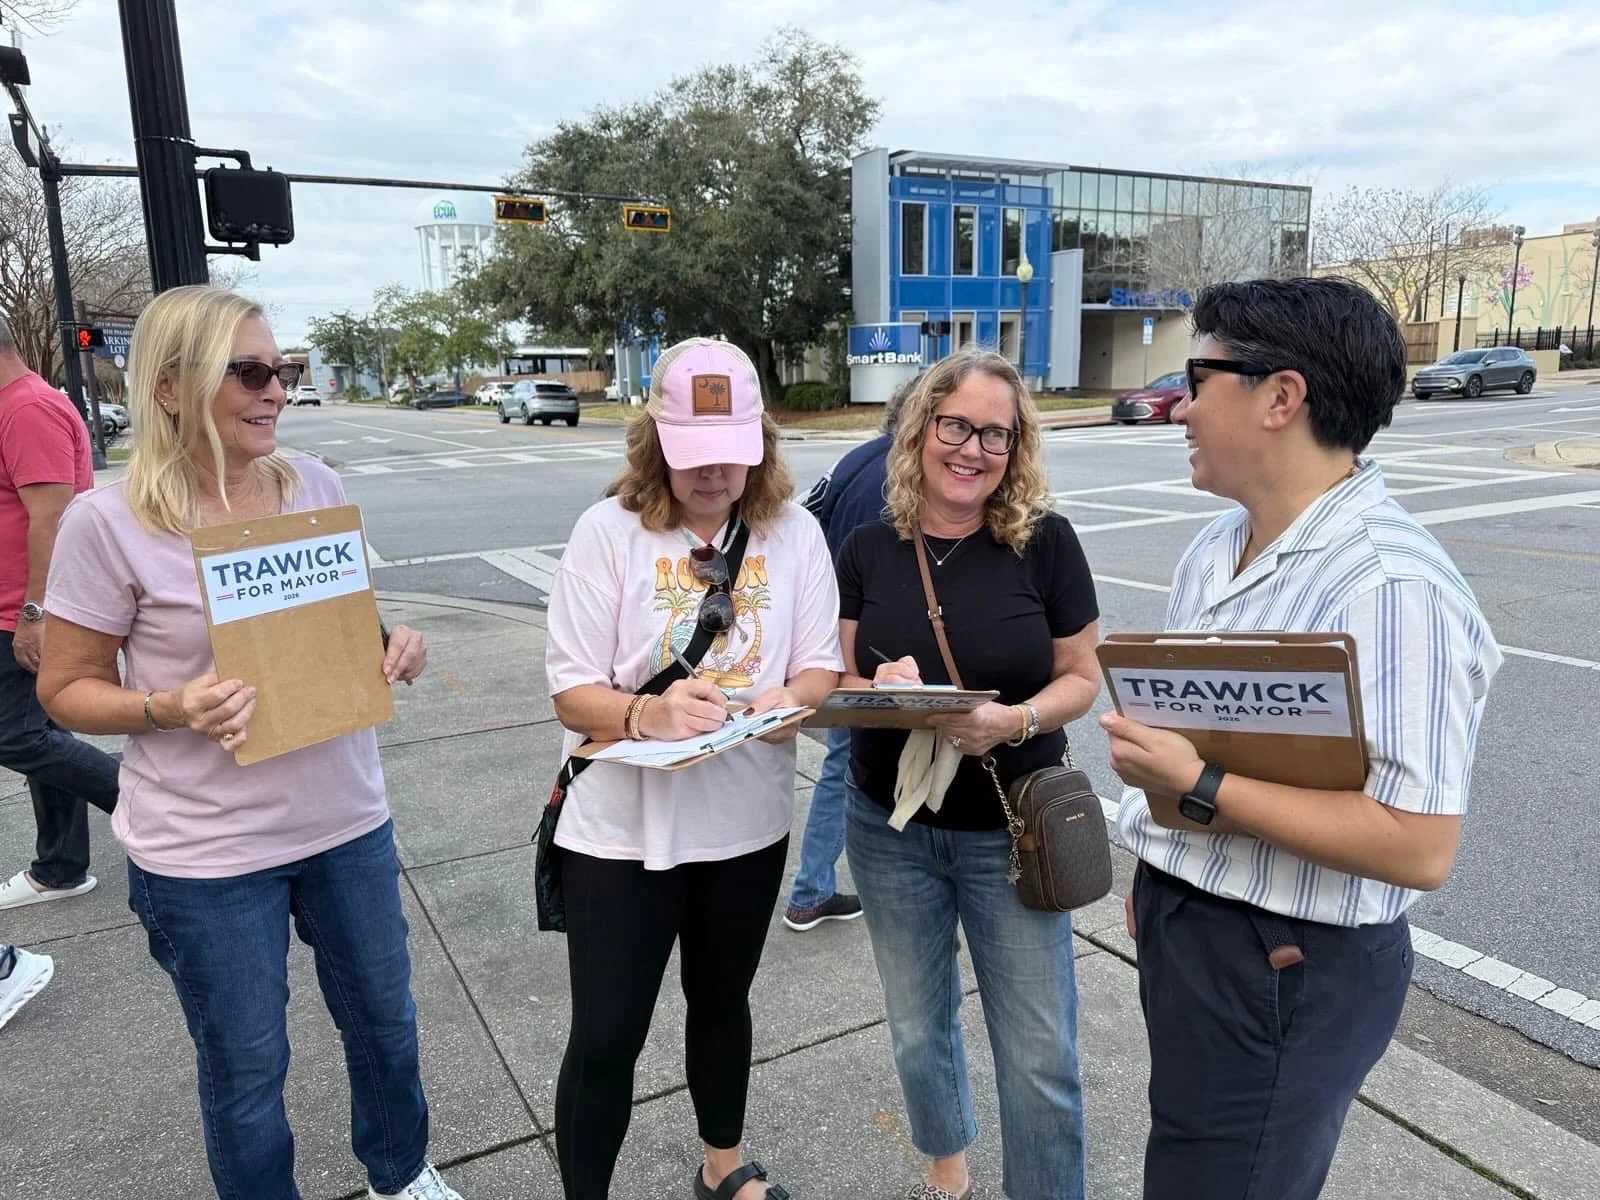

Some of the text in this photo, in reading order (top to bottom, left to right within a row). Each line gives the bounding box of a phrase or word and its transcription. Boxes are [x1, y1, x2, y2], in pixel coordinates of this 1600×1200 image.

[103, 336, 130, 345] ARKIN
[110, 345, 126, 354] LOT
[846, 351, 921, 365] SmartBank
[211, 541, 354, 587] TRAWICK
[237, 570, 339, 600] FOR MAYOR
[283, 592, 299, 601] 2026
[1122, 677, 1329, 703] TRAWICK
[842, 695, 973, 705] TRAWICK
[1153, 701, 1303, 717] FOR MAYOR
